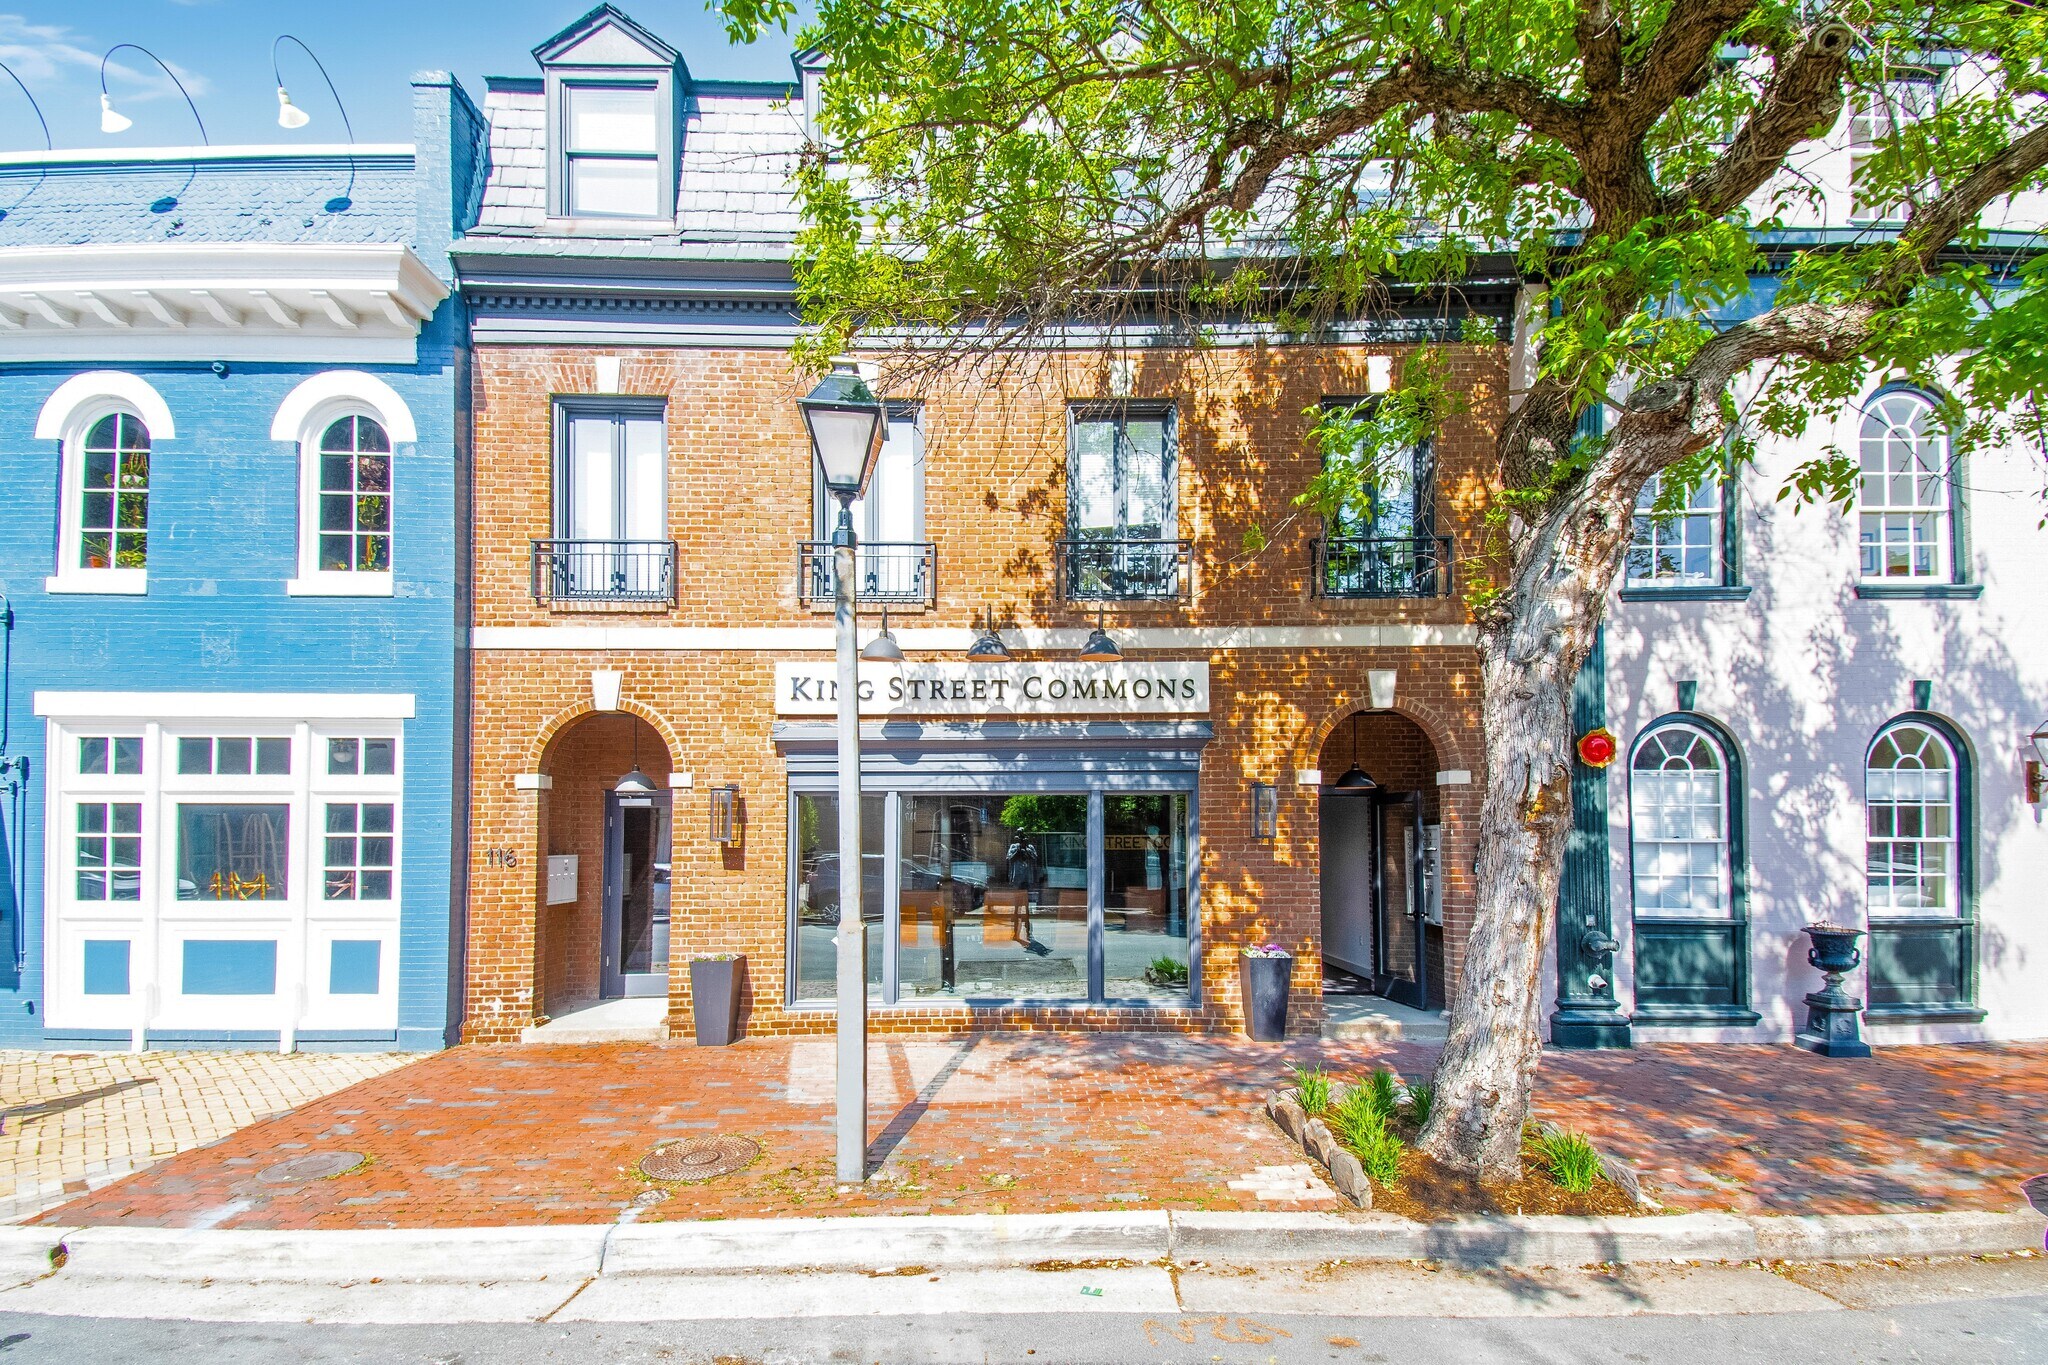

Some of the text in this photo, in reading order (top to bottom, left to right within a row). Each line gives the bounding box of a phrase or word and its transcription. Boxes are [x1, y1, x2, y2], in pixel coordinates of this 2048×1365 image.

[888, 676, 1009, 701] STREET
[1022, 676, 1196, 700] COMMONS
[487, 847, 517, 868] 116
